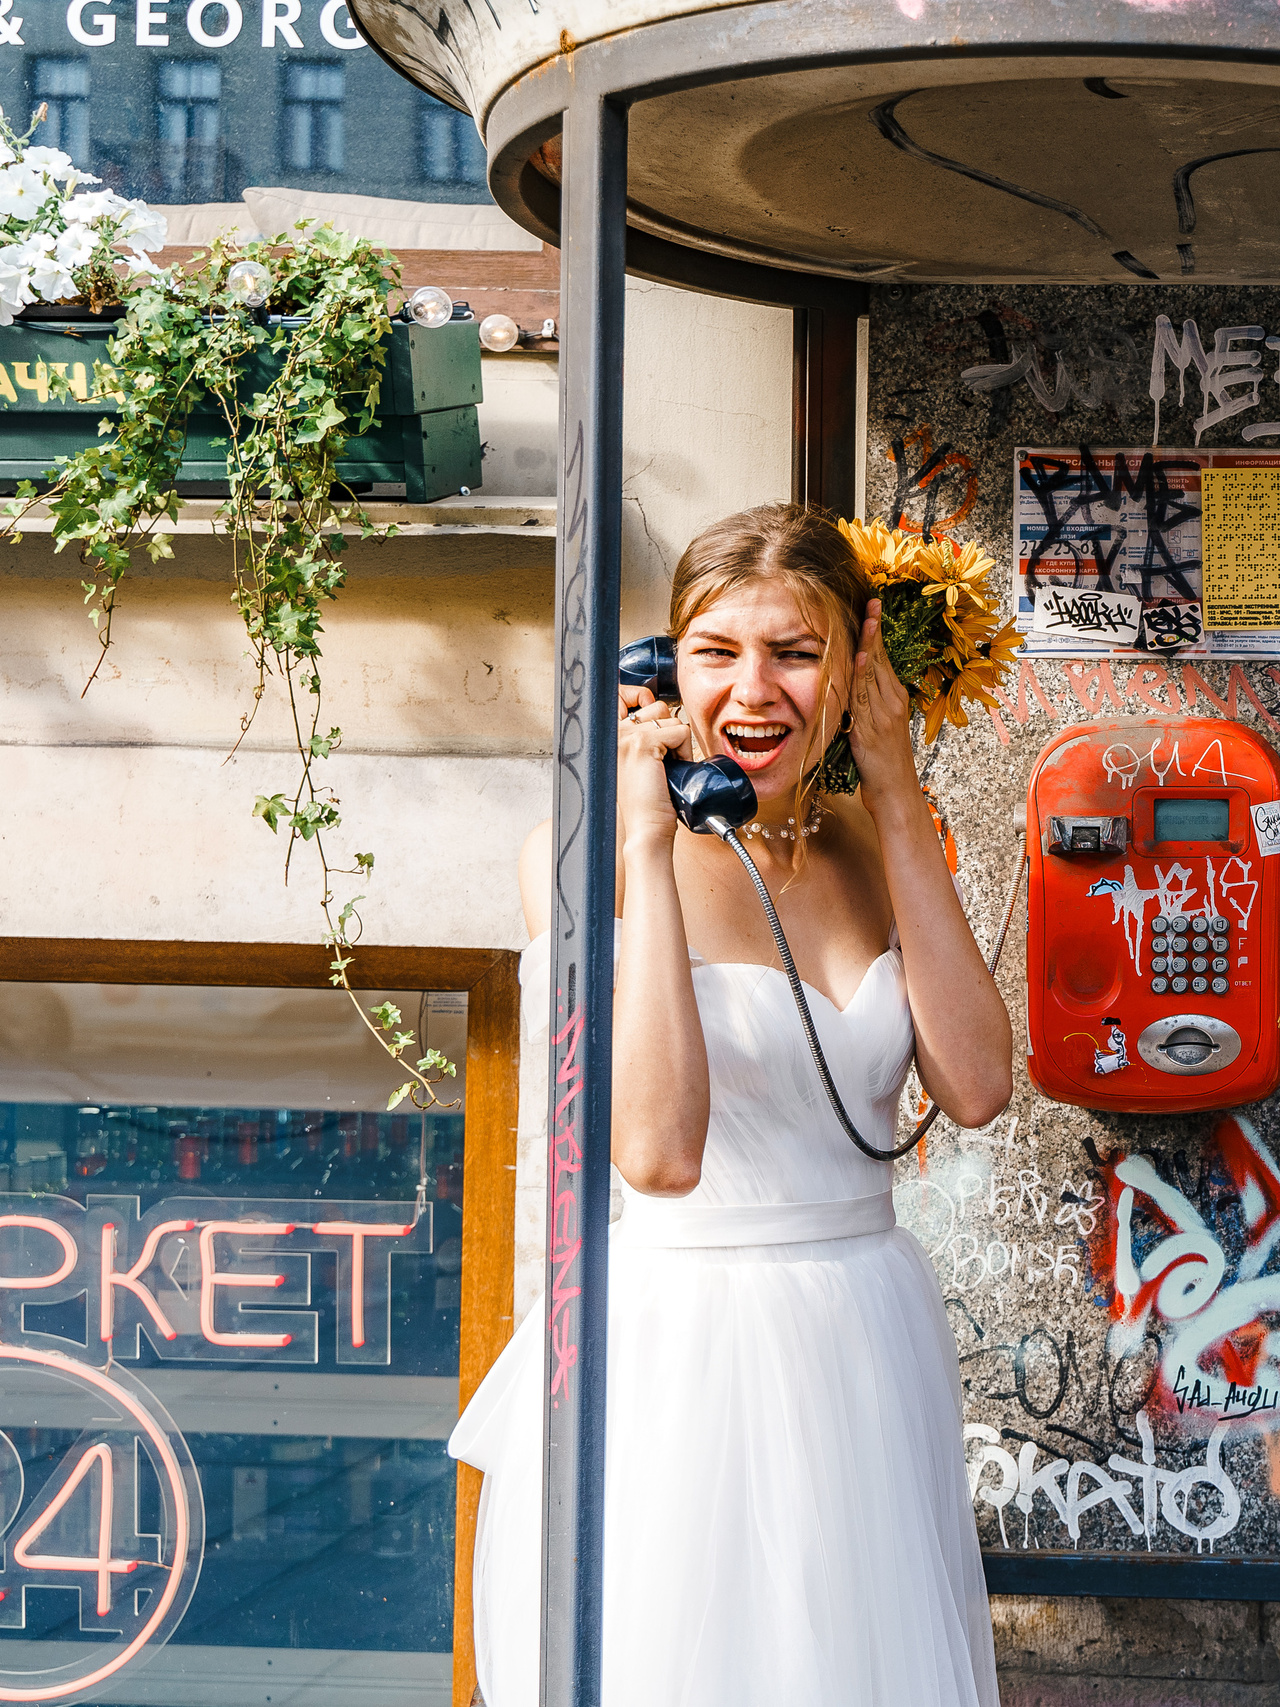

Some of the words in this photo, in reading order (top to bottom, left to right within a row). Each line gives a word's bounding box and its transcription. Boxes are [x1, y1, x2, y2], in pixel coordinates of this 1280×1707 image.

[1120, 513, 1128, 522] 2
[1119, 547, 1127, 556] 4
[1239, 937, 1247, 950] F
